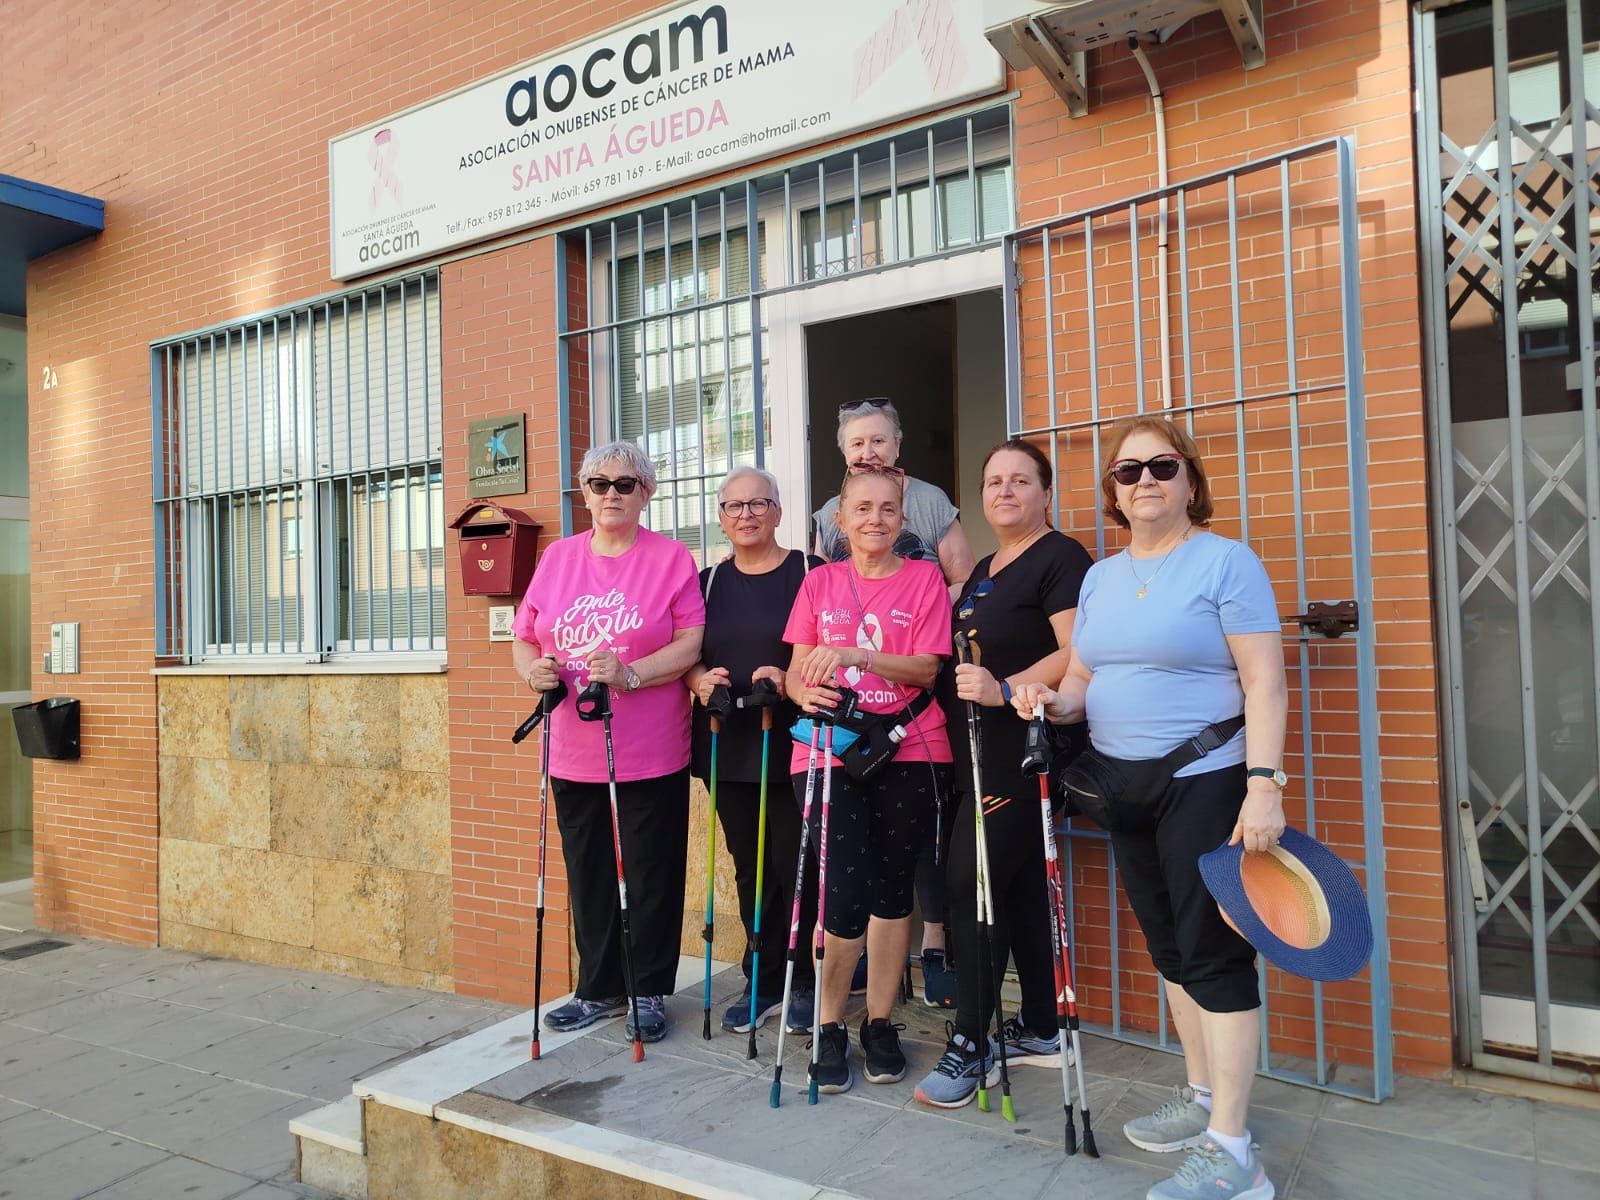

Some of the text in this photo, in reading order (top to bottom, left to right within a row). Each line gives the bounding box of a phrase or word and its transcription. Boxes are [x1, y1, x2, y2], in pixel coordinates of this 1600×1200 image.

[505, 4, 729, 127] aocam
[459, 42, 795, 170] ASOCIACIÓN ONUBENSE DE CÁNCER DE MAMA
[512, 99, 729, 191] SANTA ÁGUEDA
[488, 208, 503, 221] 959
[506, 202, 522, 217] 812
[525, 196, 541, 211] 345
[551, 185, 581, 203] Móvil:
[583, 178, 601, 193] 659
[604, 172, 621, 187] 781
[627, 165, 644, 180] 169
[656, 151, 693, 172] E-Mail:
[697, 111, 831, 160] aocam@hotmail.com
[359, 229, 420, 263] aocam
[363, 220, 414, 242] SANTA ÁGUEDA
[475, 465, 495, 477] Obra
[564, 588, 625, 623] Ante
[610, 605, 643, 634] tú
[857, 690, 898, 704] ocam
